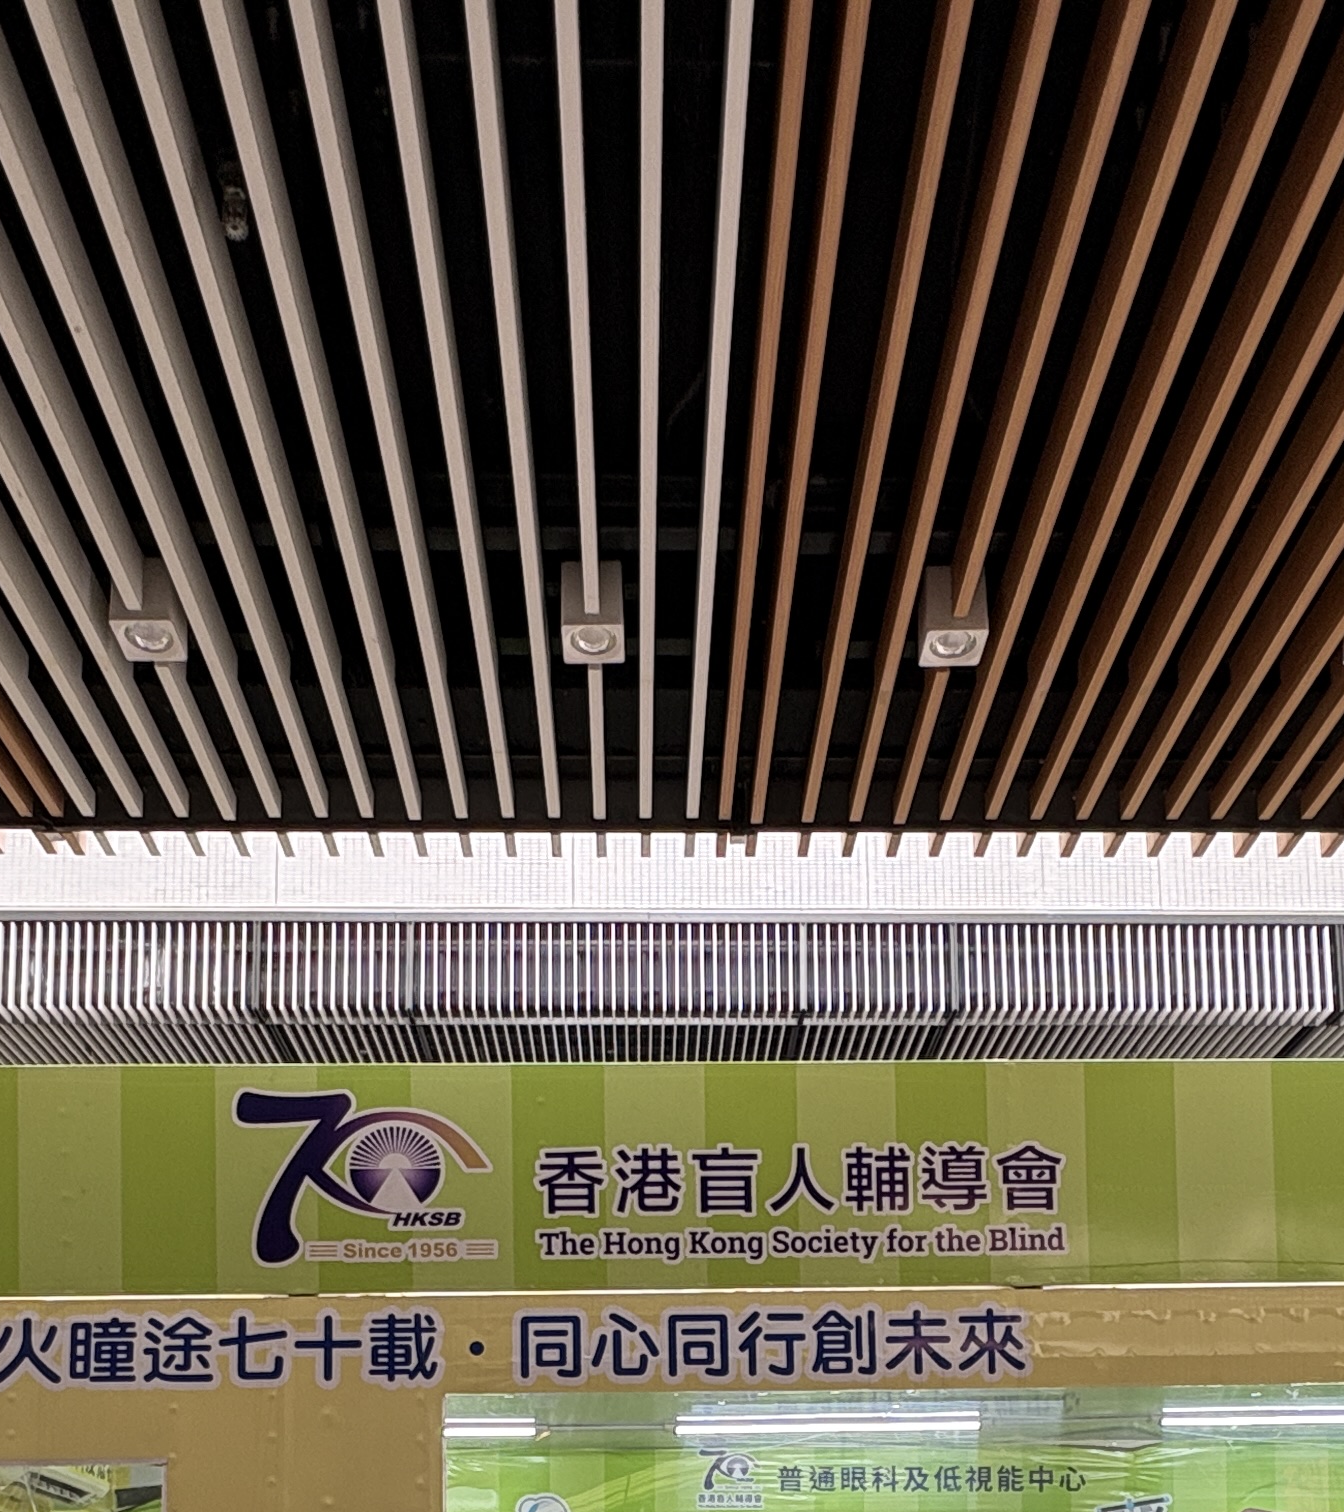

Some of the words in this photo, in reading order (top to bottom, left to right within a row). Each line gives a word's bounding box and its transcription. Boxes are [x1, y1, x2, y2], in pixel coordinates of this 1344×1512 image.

[538, 1144, 1063, 1216] 香港盲人輔導會
[392, 1211, 462, 1227] HKSB
[343, 1241, 402, 1260] Since
[408, 1241, 458, 1259] 1956
[540, 1230, 594, 1256] The
[603, 1230, 681, 1262] Hong
[689, 1230, 764, 1261] Kong
[773, 1228, 877, 1260] Society
[885, 1227, 928, 1253] for
[933, 1228, 981, 1254] the
[989, 1227, 1064, 1253] Blind
[776, 1465, 1087, 1493] 普通眼科及低視能中心
